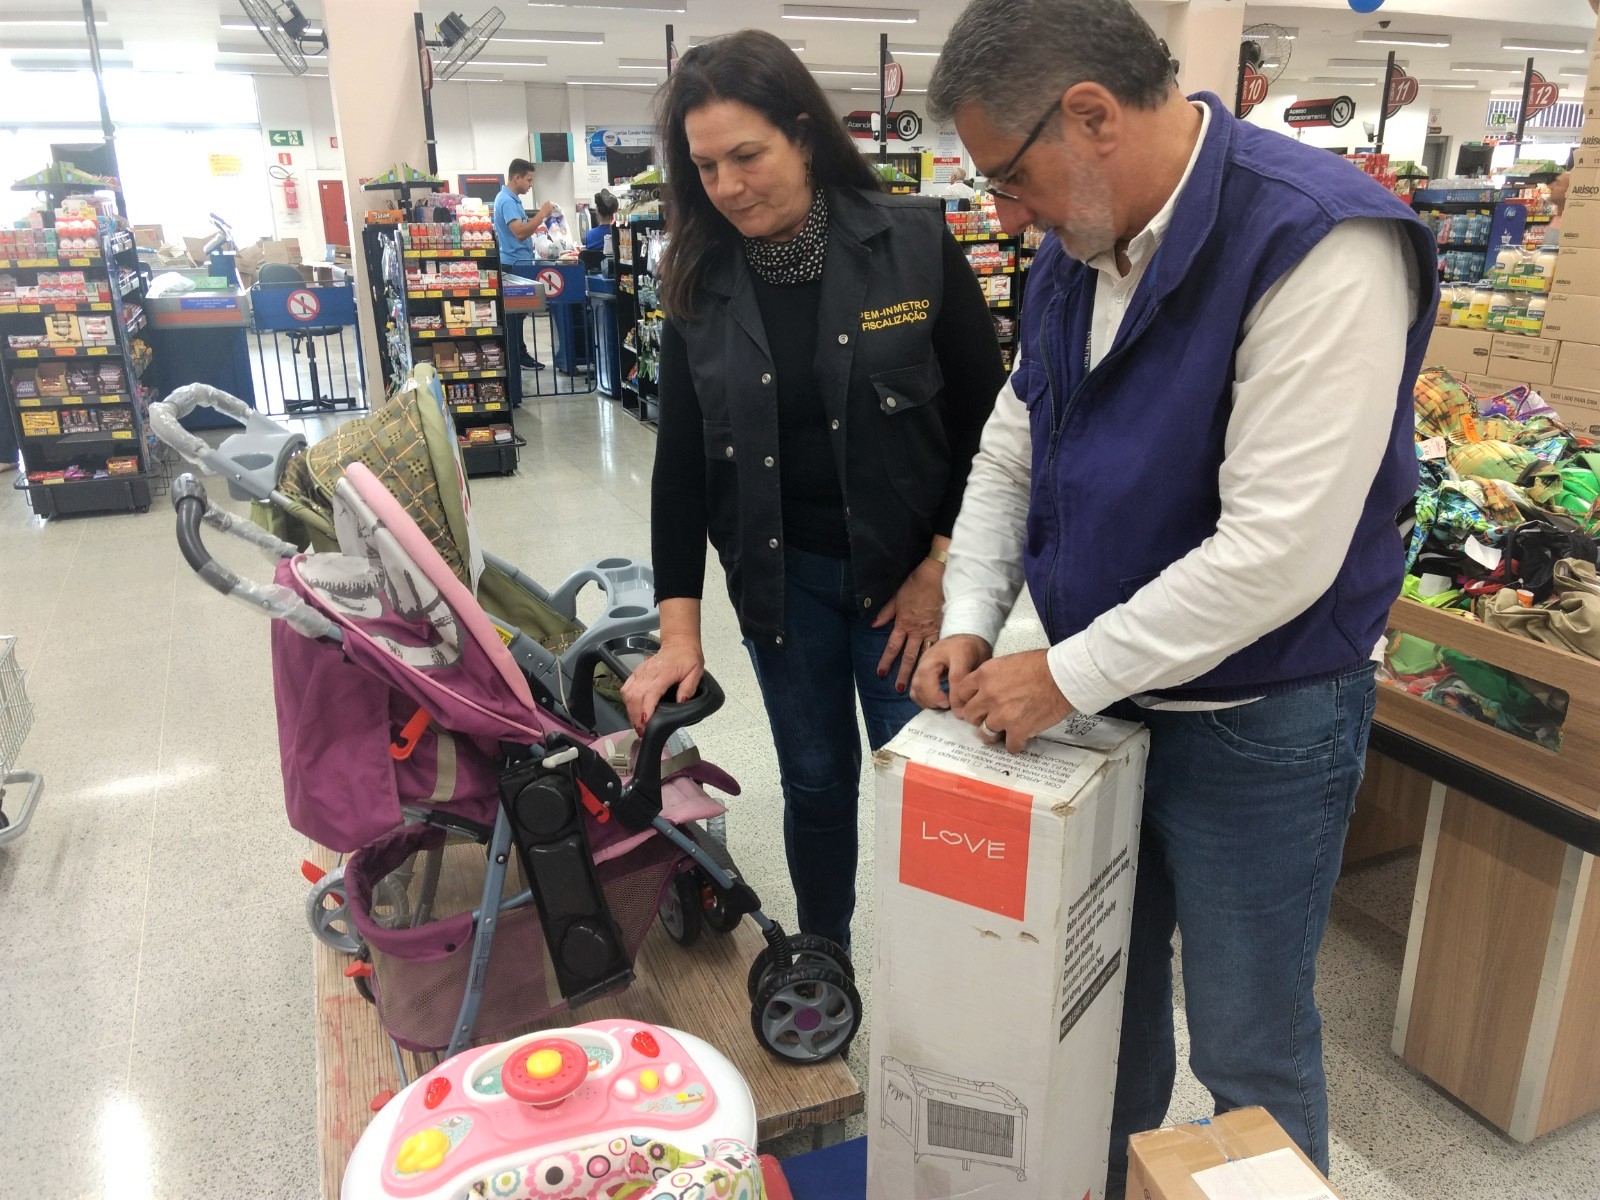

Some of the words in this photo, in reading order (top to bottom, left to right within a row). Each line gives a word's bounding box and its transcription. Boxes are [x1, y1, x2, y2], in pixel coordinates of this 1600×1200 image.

[1248, 79, 1262, 100] 10
[1396, 81, 1411, 101] 11
[1535, 86, 1552, 104] 12
[1572, 184, 1599, 194] ARISCO
[862, 310, 928, 331] FISCALIZAÇÃO
[938, 751, 971, 764] LISTRADO
[964, 752, 993, 763] MODELO
[974, 749, 994, 758] FIRST
[994, 755, 1013, 763] BABY
[985, 764, 1001, 772] PINK
[995, 762, 1021, 772] VIAGEM
[1040, 755, 1081, 769] FABRICADO
[1022, 769, 1040, 777] PARA
[1029, 765, 1071, 779] IMPORTADO
[1041, 774, 1066, 784] BERÇO
[922, 820, 1006, 859] LOVE
